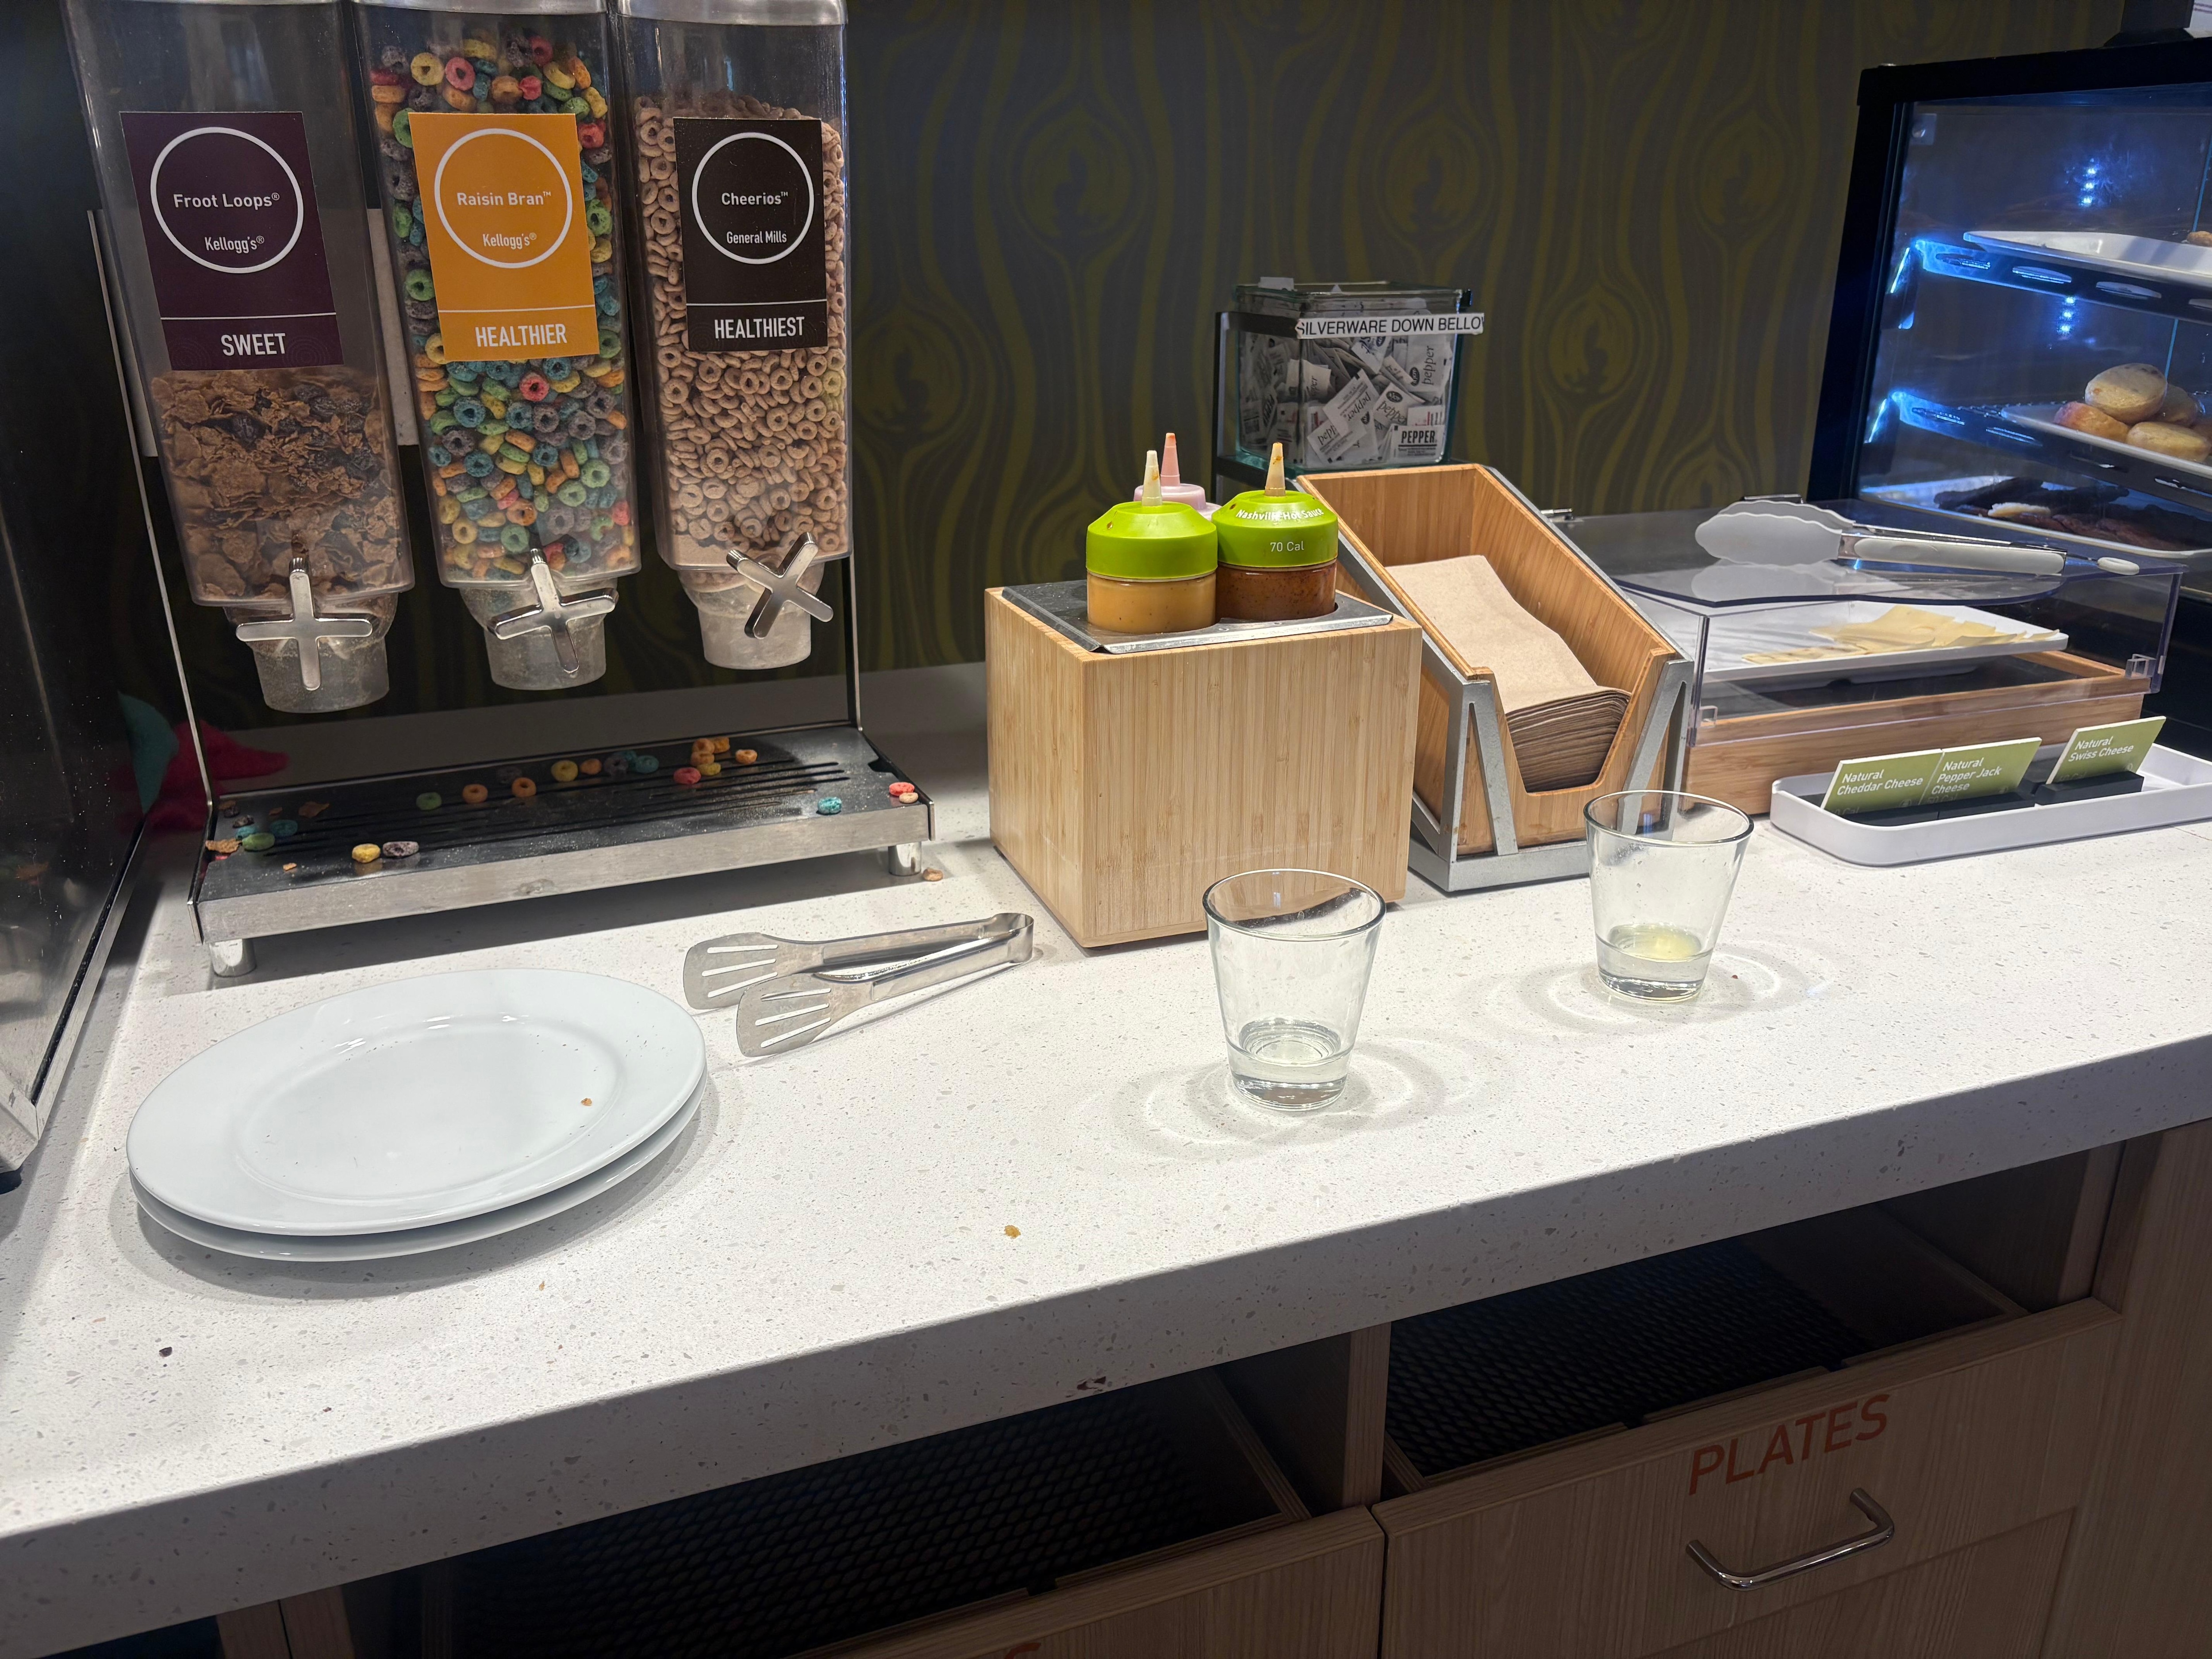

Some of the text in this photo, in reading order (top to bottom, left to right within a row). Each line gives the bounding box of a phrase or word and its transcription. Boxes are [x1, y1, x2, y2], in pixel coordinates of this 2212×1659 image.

[173, 194, 218, 208] Froot
[457, 192, 504, 206] Raisin
[726, 231, 787, 244] General Mills
[714, 316, 805, 339] HEALTHIEST
[1391, 318, 1434, 333] DOWN
[1438, 315, 1484, 330] BELLO
[475, 324, 568, 347] HEALTHIER
[221, 332, 287, 357] SWEET
[1421, 346, 1436, 385] pepper
[1347, 391, 1371, 421] pepper
[1401, 430, 1436, 443] PEPPER
[1235, 509, 1281, 521] Nashvill
[1301, 508, 1324, 518] Sauce
[1270, 541, 1304, 552] 70 Cal
[2074, 736, 2113, 751] Natural
[2068, 745, 2134, 762] Swiss Cheese
[1943, 757, 1985, 772] Natural
[1841, 769, 1885, 784] Natural
[1937, 766, 2002, 783] Pepper Jack
[1837, 776, 1924, 796] Cheddar Cheese
[1931, 782, 1970, 795] Cheese
[1689, 1393, 1890, 1496] PLATES
